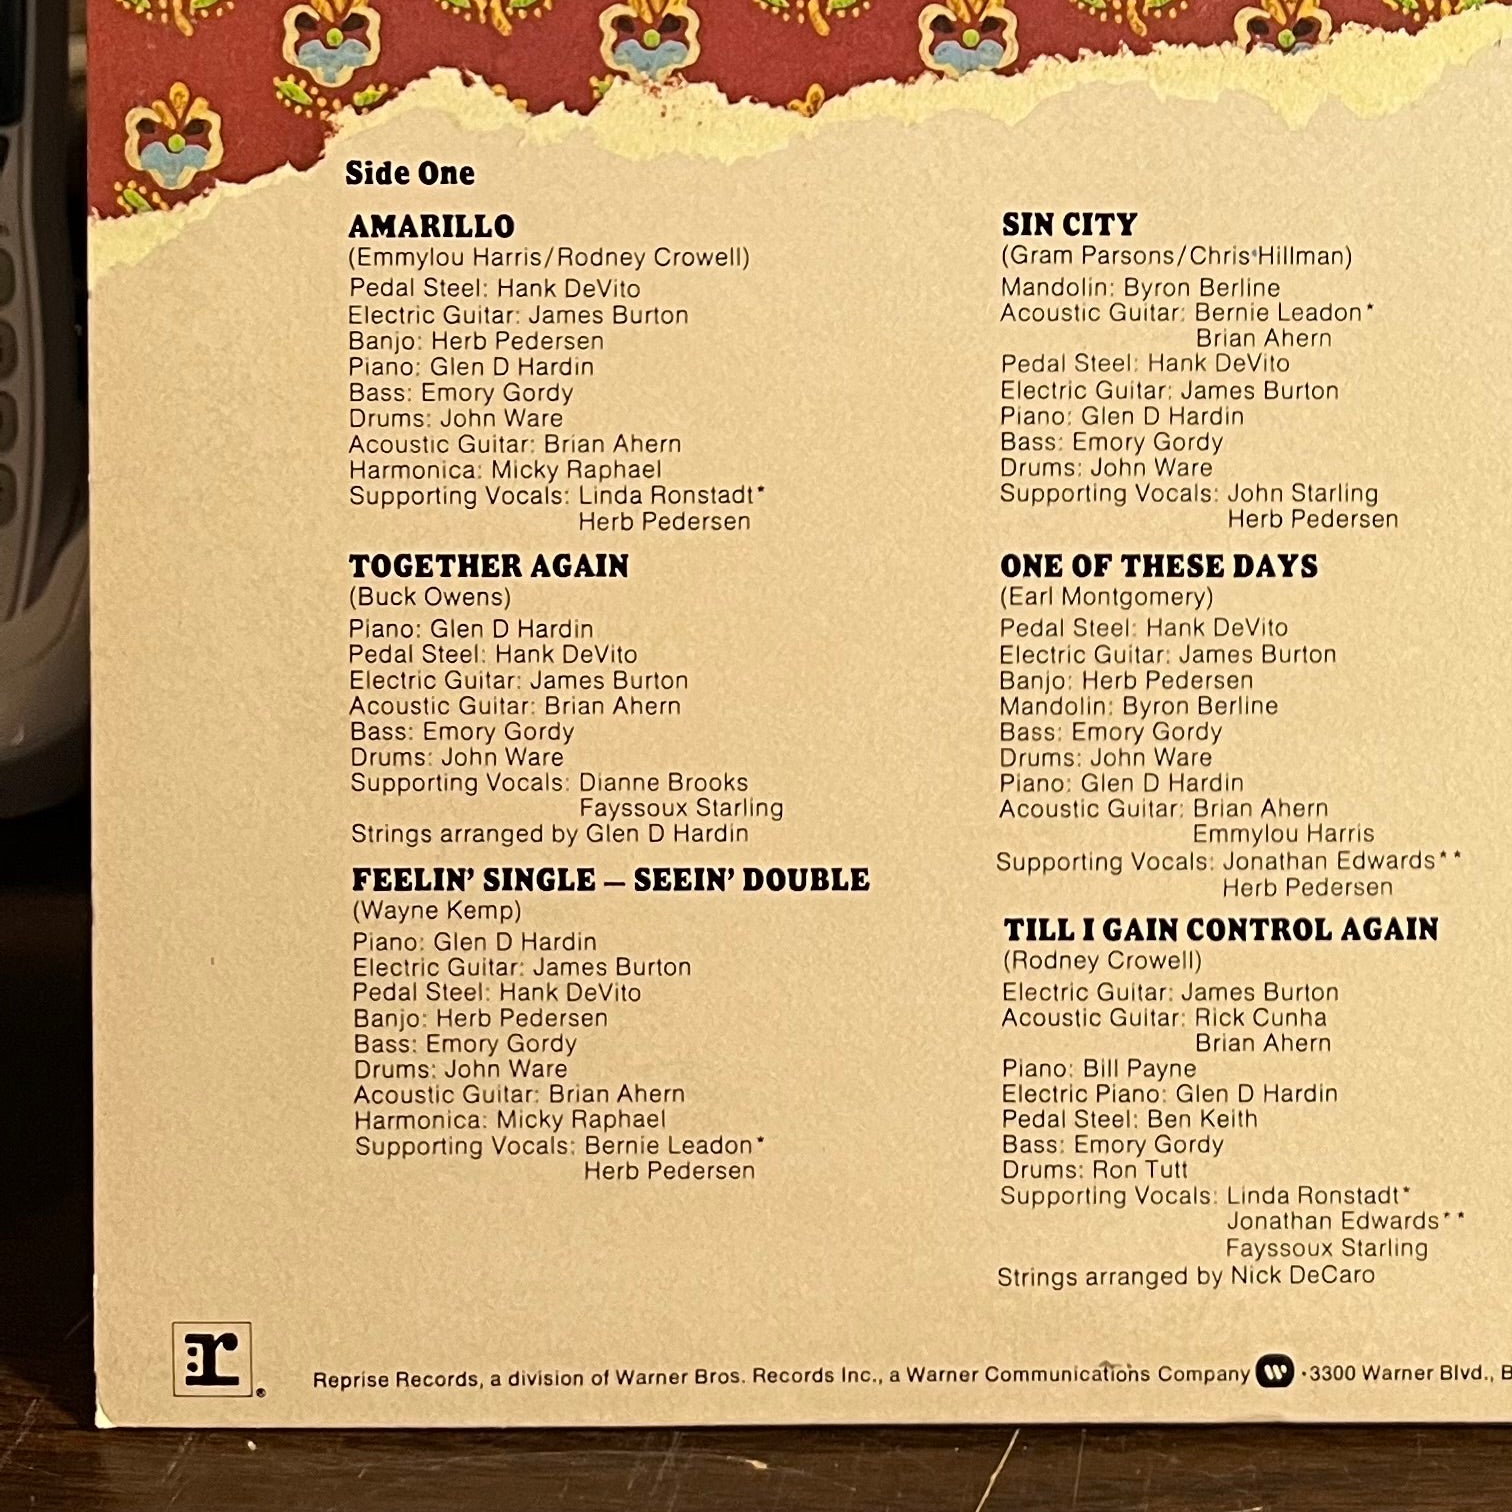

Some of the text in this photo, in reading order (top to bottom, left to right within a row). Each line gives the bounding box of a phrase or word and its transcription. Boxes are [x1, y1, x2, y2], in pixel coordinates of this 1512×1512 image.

[345, 159, 475, 186] Side One
[347, 213, 515, 239] AMARILLO
[1002, 211, 1139, 237] SIN CITY
[348, 246, 464, 272] (Emmylou
[654, 246, 750, 271] Crowell)
[1001, 276, 1281, 302] Mandolin: Byron Berline
[348, 552, 629, 579] TOGETHER AGAIN
[1000, 552, 1318, 579] ONE OF THESE DAYS
[349, 585, 511, 611] (Buck Owens)
[1000, 585, 1213, 611] (Earl Montgomery)
[1000, 669, 1253, 695] Banjo: Herb Pedersen
[483, 867, 596, 892] SINGLE
[742, 867, 871, 892] DOUBLE
[353, 899, 521, 925] (Wayne Kemp)
[1003, 916, 1439, 943] TILL I GAIN CONTROL AGAIN
[1003, 949, 1202, 975] (Rodney Crowell)
[1001, 1007, 1327, 1028] Acoustic Guitar: Rick Cunha
[354, 1108, 666, 1134] Harmonica: Micky Raphael
[1003, 1159, 1188, 1180] Drums: Ron Tutt
[313, 1370, 389, 1393] Reprise
[396, 1370, 484, 1390] Records,
[490, 1373, 502, 1387] a
[508, 1369, 584, 1387] division
[591, 1369, 610, 1387] of
[615, 1369, 689, 1386] Warner
[694, 1368, 746, 1385] Bros.
[752, 1367, 835, 1384] Records
[841, 1366, 883, 1385] Inc.,
[889, 1370, 901, 1383] a
[906, 1366, 980, 1383] Warner
[984, 1365, 1151, 1383] Communications
[1158, 1365, 1251, 1386] Company
[1309, 1364, 1356, 1382] 3300
[1361, 1364, 1435, 1382] Warner
[1440, 1364, 1494, 1383] Blvd.,
